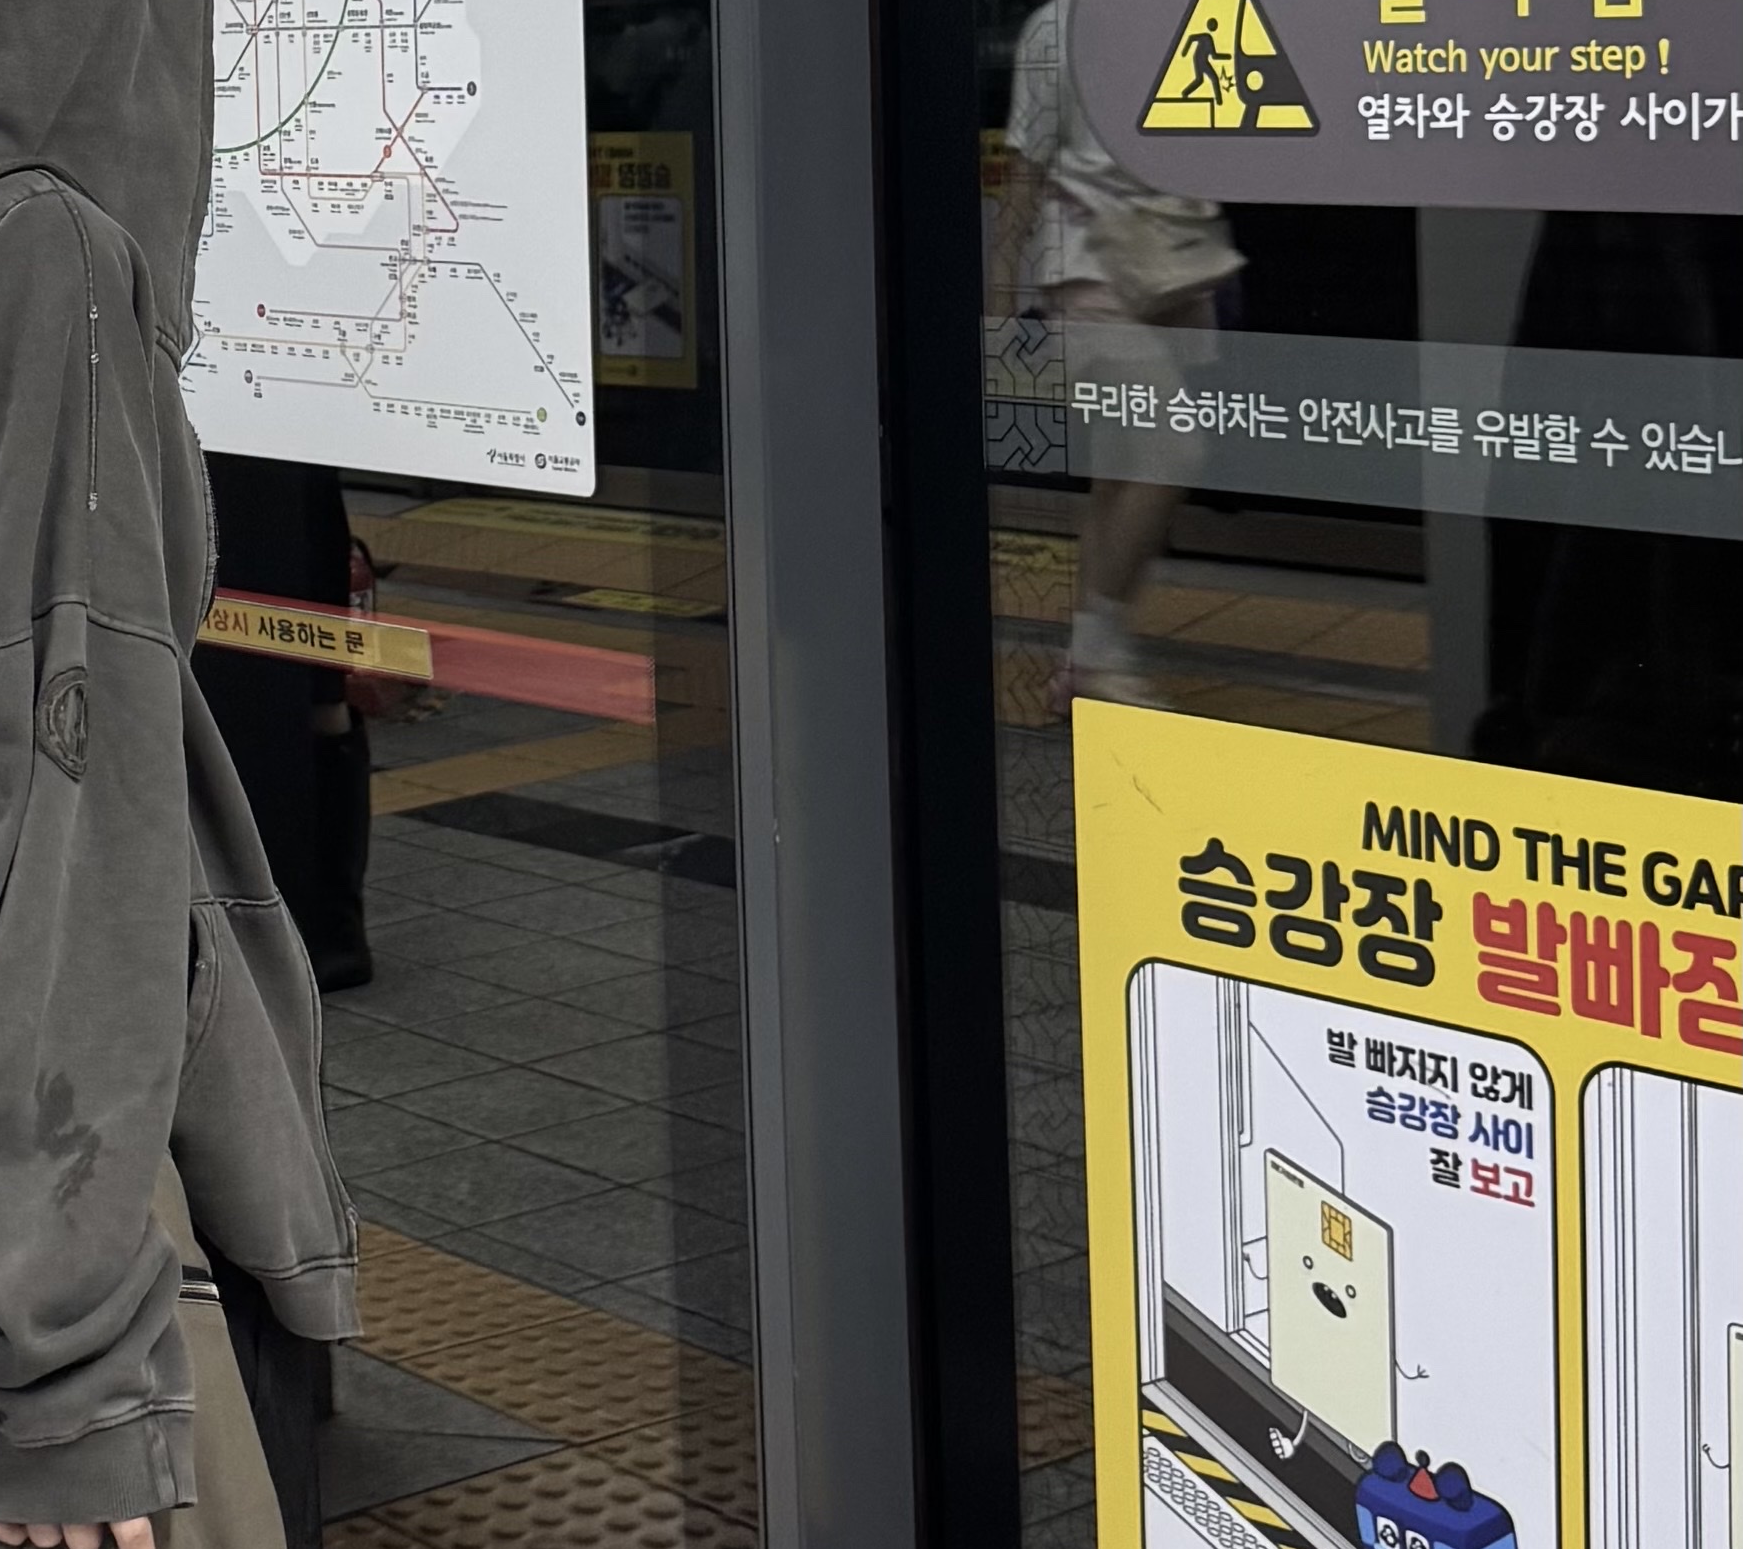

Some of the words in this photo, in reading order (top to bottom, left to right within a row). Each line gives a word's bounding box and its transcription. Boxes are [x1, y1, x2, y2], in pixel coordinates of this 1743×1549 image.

[1363, 39, 1467, 75] Watch
[1483, 45, 1558, 80] your
[1358, 93, 1469, 141] 열차와
[1484, 91, 1605, 141] 승강장
[1071, 381, 1158, 429] 무리한
[1166, 389, 1289, 440] 승하차는
[1299, 396, 1463, 455] 안전사고를
[1473, 410, 1579, 467] 유발할
[1589, 420, 1629, 466] 수
[258, 615, 336, 651] 사용하는
[345, 630, 365, 655] 문
[1362, 801, 1500, 871] MIND
[1513, 826, 1627, 897] THE
[1179, 837, 1442, 987] 승강장
[1326, 1028, 1357, 1068] 발
[1364, 1035, 1460, 1094] 빠지지
[1468, 1062, 1533, 1111] 않게
[1364, 1085, 1460, 1140] 승강장
[1468, 1110, 1534, 1160] 사이
[1429, 1148, 1462, 1189] 잘
[1469, 1158, 1535, 1208] 보고
